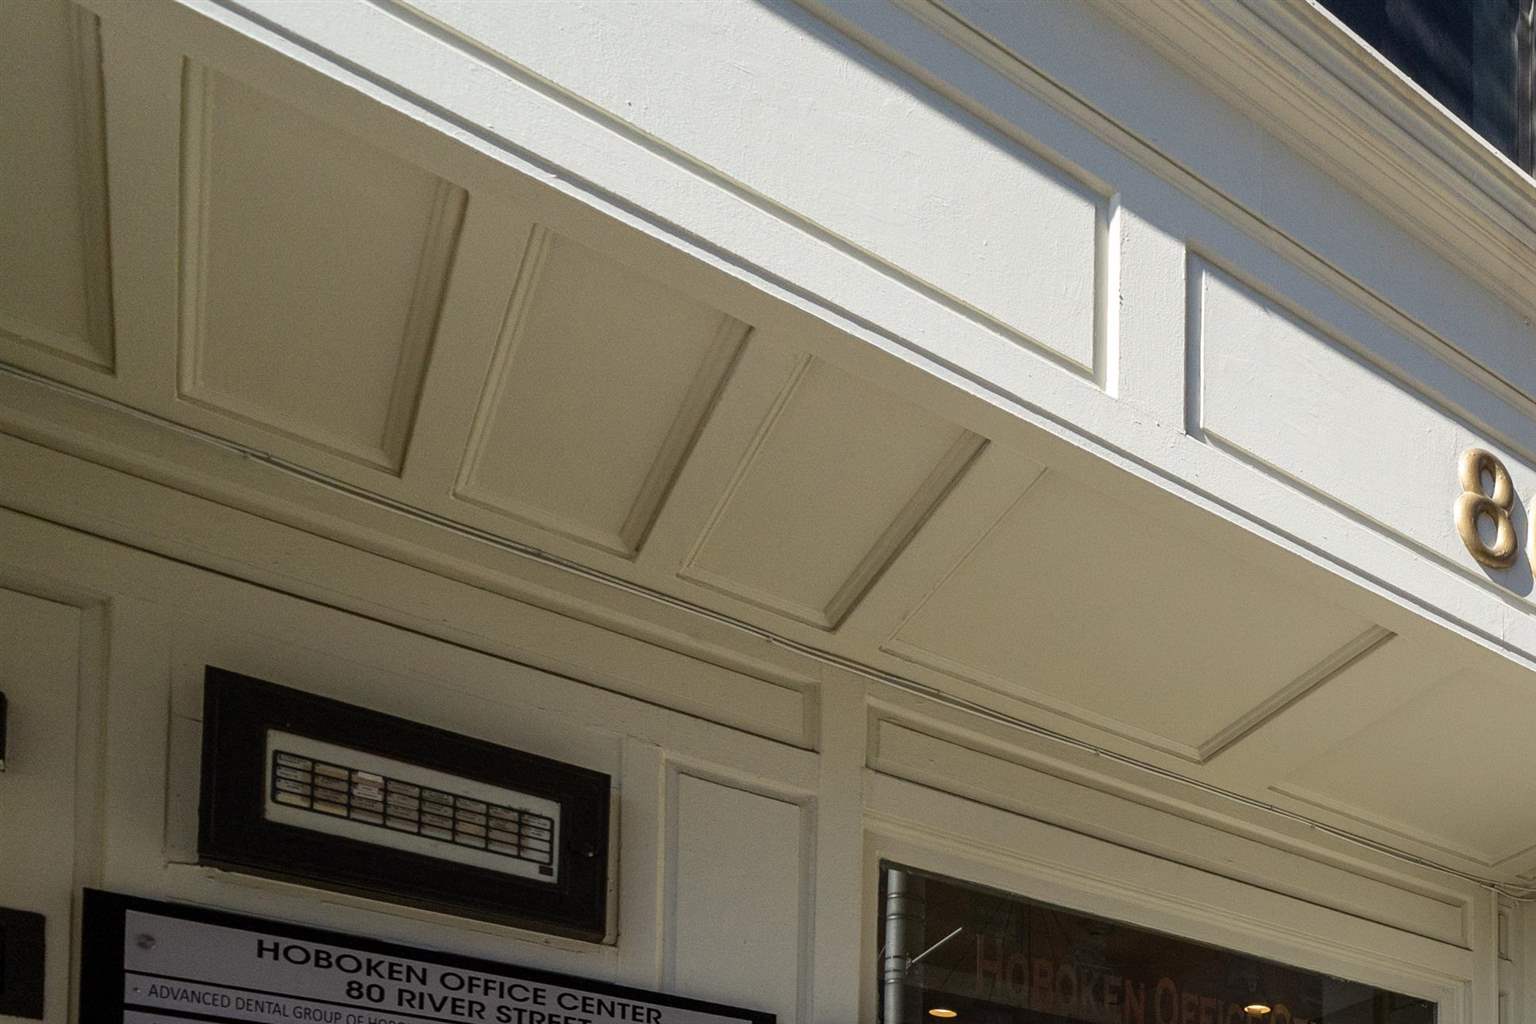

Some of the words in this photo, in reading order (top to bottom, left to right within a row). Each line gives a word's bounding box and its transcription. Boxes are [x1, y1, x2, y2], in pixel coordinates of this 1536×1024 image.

[256, 938, 427, 986] HOBOKEN
[439, 971, 546, 1006] OFFICE
[147, 983, 230, 1008] ADVANCED
[235, 996, 289, 1017] DENTAL
[292, 1005, 342, 1023] GROUP
[345, 979, 385, 1003] 80
[397, 987, 486, 1019] RIVER
